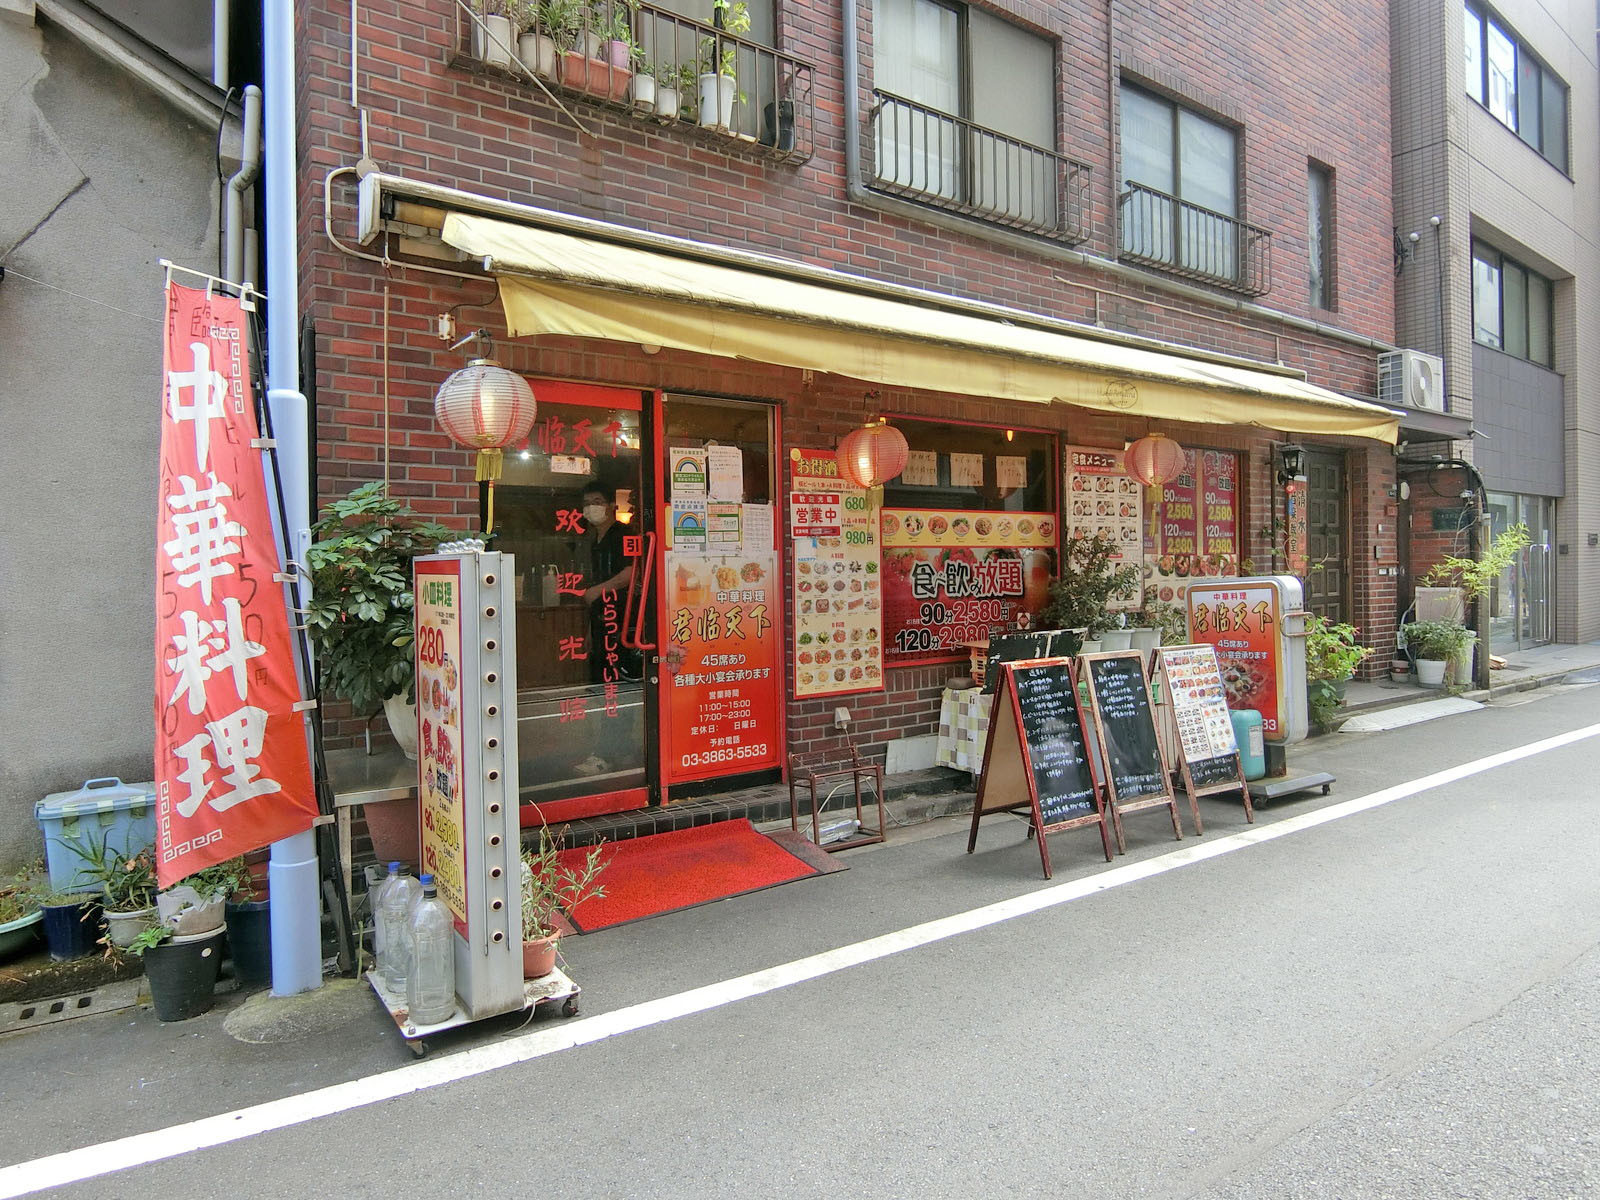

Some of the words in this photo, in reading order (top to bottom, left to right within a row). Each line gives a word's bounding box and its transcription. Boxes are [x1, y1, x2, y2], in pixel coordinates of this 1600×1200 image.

[845, 496, 866, 510] 680
[796, 507, 837, 524] 営業中
[625, 538, 641, 553] 引
[164, 341, 282, 818] 中華料理
[911, 559, 1024, 598] 食べ飲み放題
[716, 589, 765, 604] 中華料理
[1213, 592, 1247, 600] 中華料理
[1217, 640, 1249, 649] 45席あり
[601, 587, 619, 718] いらっしゃいませ
[701, 653, 747, 667] 45席あり
[674, 667, 771, 688] 各種大小宴会承ります
[709, 689, 740, 700] 営業時間
[733, 719, 757, 731] 日曜日
[709, 735, 741, 748] 予約電話
[681, 743, 767, 768] 03-3863-5533
